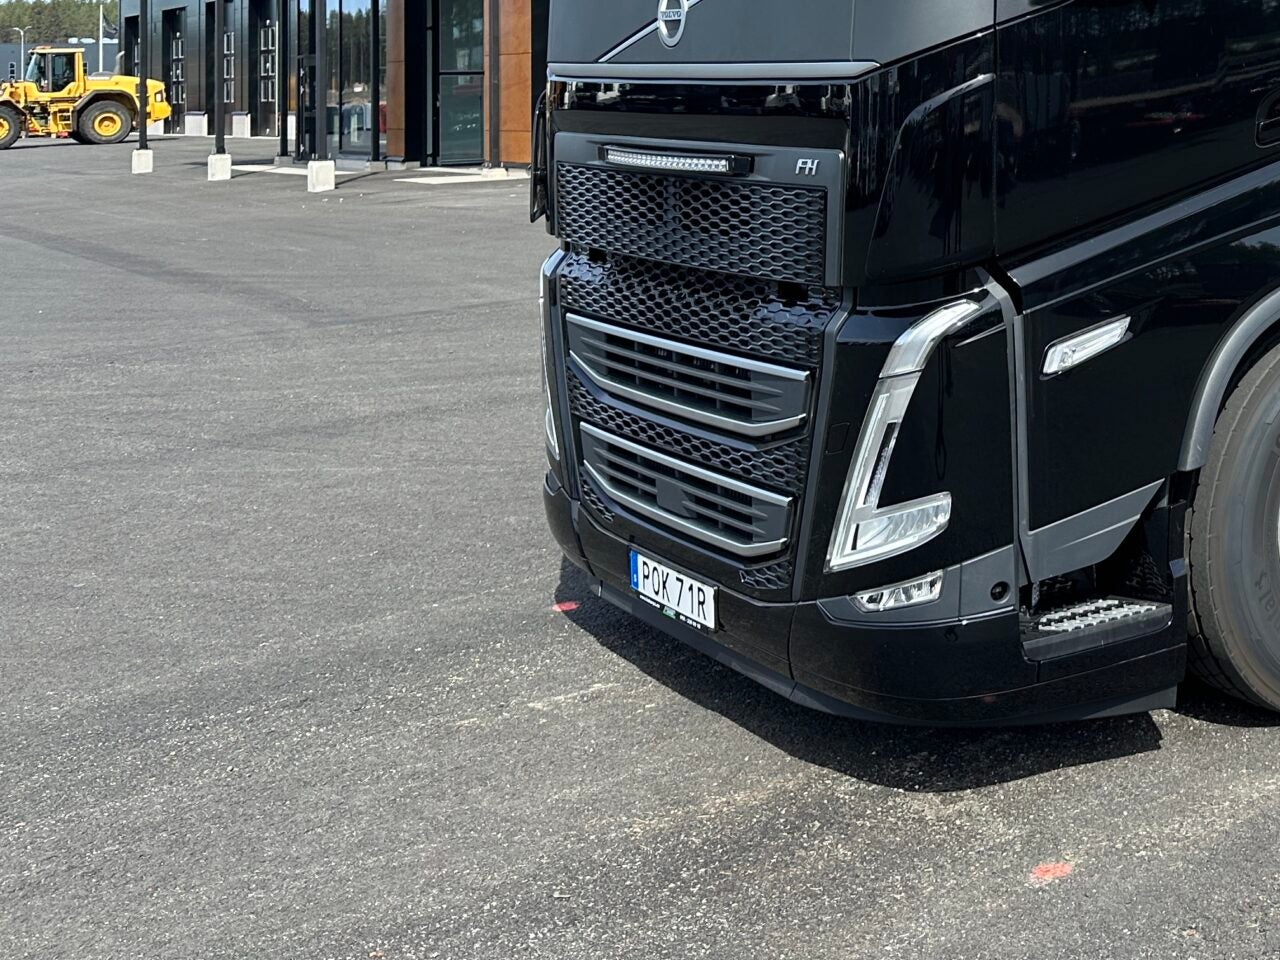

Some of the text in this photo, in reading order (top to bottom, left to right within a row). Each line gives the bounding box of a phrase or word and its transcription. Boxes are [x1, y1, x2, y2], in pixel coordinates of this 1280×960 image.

[660, 10, 682, 19] VOLVO
[795, 158, 820, 176] FH
[642, 560, 707, 621] POK 71R
